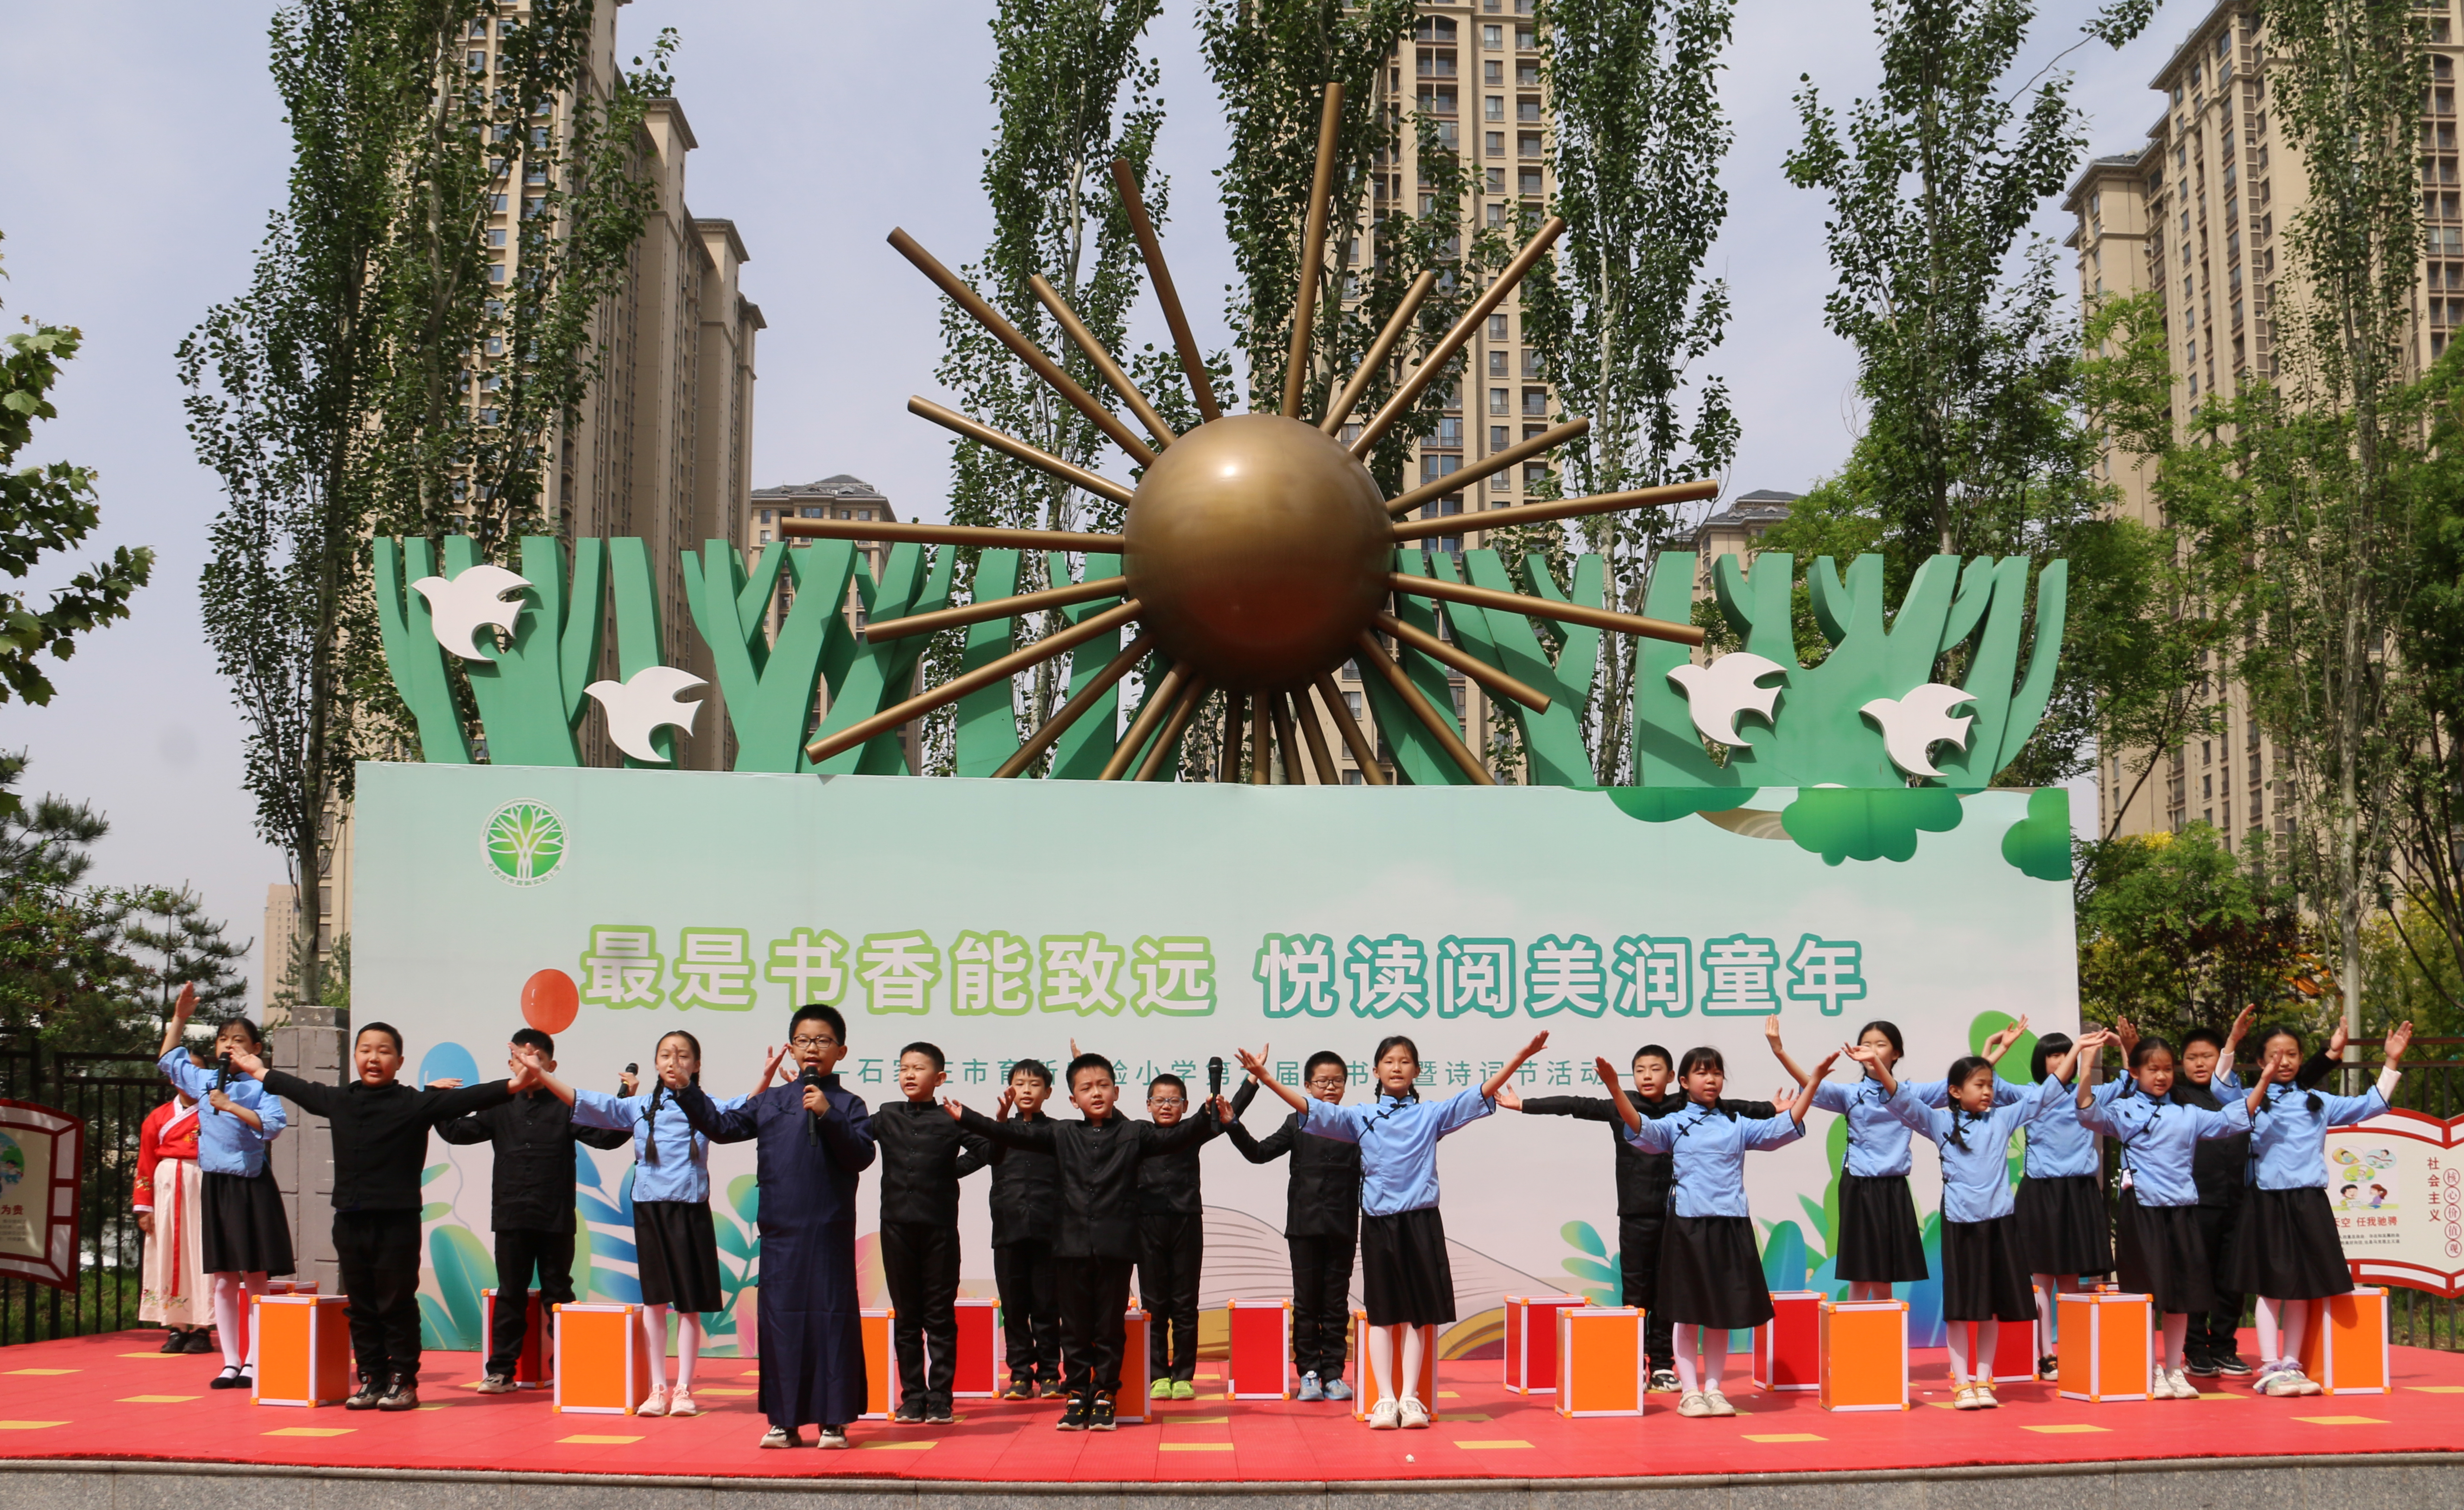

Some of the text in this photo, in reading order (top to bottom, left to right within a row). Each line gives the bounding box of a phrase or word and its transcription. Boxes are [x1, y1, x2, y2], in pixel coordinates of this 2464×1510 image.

[581, 927, 1865, 1017] 最是书香能致远 悦读阅美润童年
[2357, 1216, 2398, 1227] 任我驰骋
[2427, 1156, 2440, 1222] 社会主义
[2445, 1170, 2461, 1256] 核心价值观
